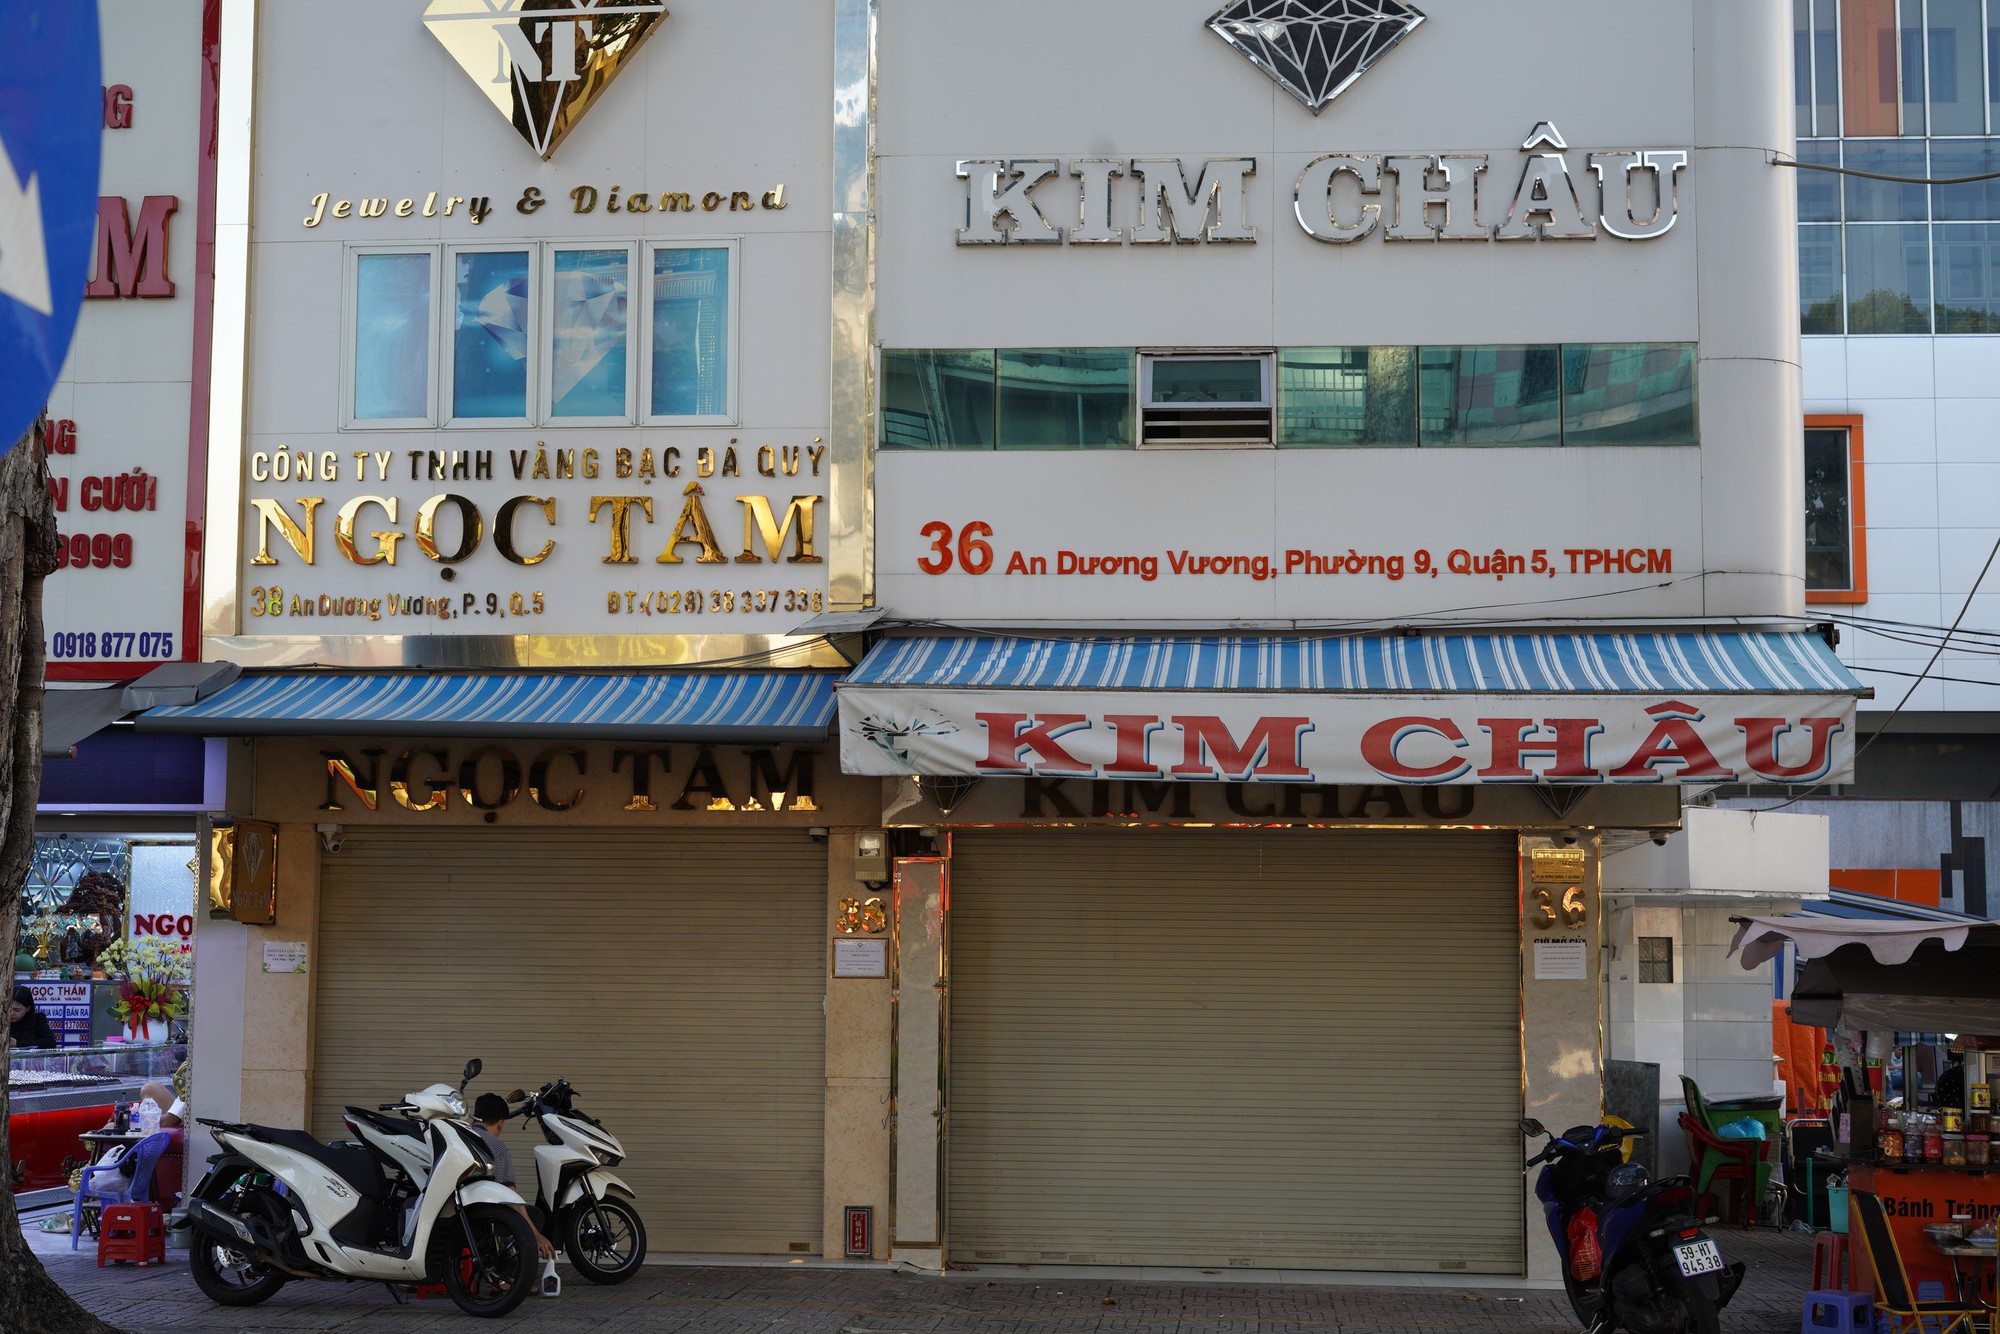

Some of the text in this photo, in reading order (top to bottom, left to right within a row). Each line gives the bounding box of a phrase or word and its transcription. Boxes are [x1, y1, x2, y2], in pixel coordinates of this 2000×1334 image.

[492, 20, 593, 84] NT
[102, 84, 133, 129] G
[954, 121, 1688, 246] KIM CHÂU
[303, 184, 789, 228] Jewelry & Diamond
[84, 195, 178, 299] M
[251, 437, 824, 484] CÔNG TY TNHH VÀNG BẠC ĐÁ QUÝ
[80, 466, 157, 511] CƯỚI
[250, 481, 824, 581] NGỌC TÂM
[917, 520, 1672, 582] 36 An Dương Vương, Phường 9, Quận 5, TPHCM
[250, 586, 283, 617] 38
[289, 594, 314, 617] An
[318, 594, 381, 621] Dương
[387, 593, 458, 620] Vương,
[740, 589, 779, 613] 337
[784, 588, 823, 613] 338
[53, 632, 173, 658] 0918 877 075
[974, 701, 1843, 784] KIM CHÂU
[318, 746, 587, 824] NGỌC
[1019, 779, 1195, 819] KIM
[836, 897, 888, 934] 38
[1531, 886, 1587, 930] 36
[1884, 1196, 1934, 1218] Bánh
[1680, 1243, 1710, 1259] 59-H1
[1682, 1255, 1720, 1274] 945.38
